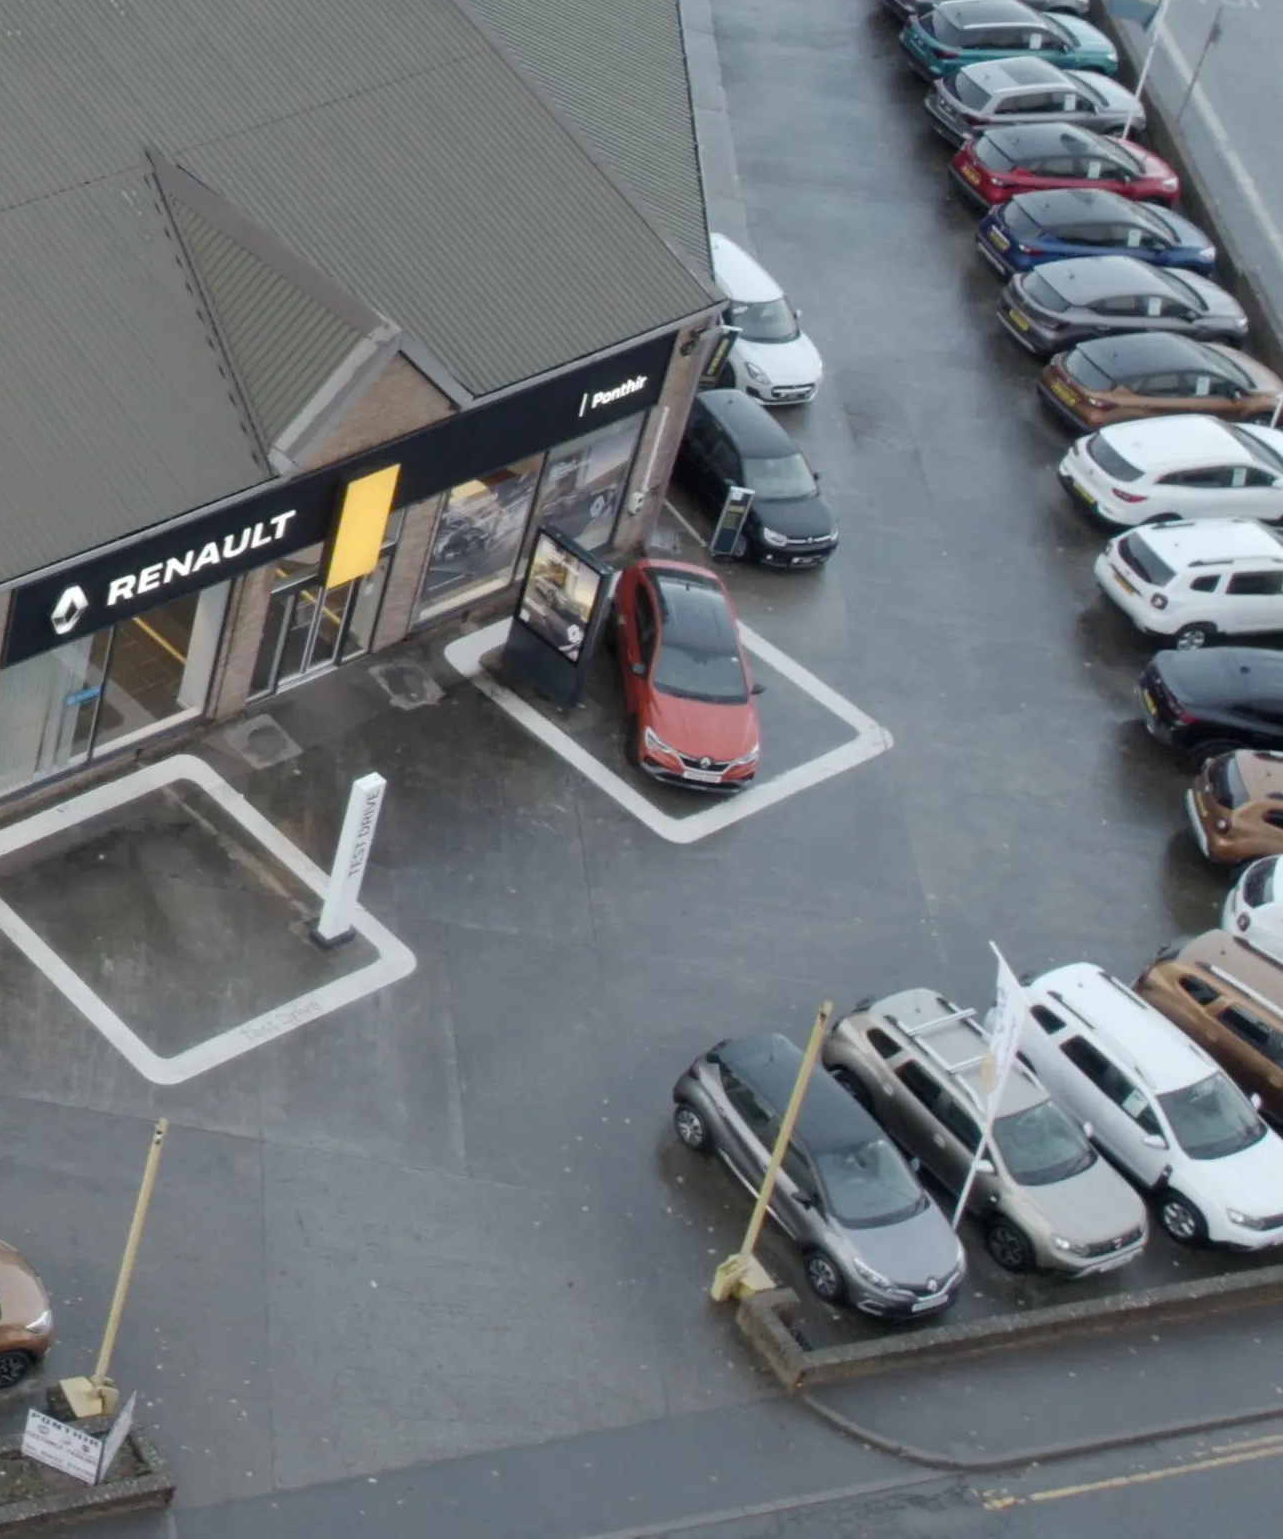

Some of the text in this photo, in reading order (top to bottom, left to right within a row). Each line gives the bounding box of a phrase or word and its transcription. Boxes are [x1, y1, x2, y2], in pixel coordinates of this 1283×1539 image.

[591, 375, 648, 409] Ponthir
[107, 509, 297, 606] RENAULT
[349, 788, 381, 879] TEST DRIVE
